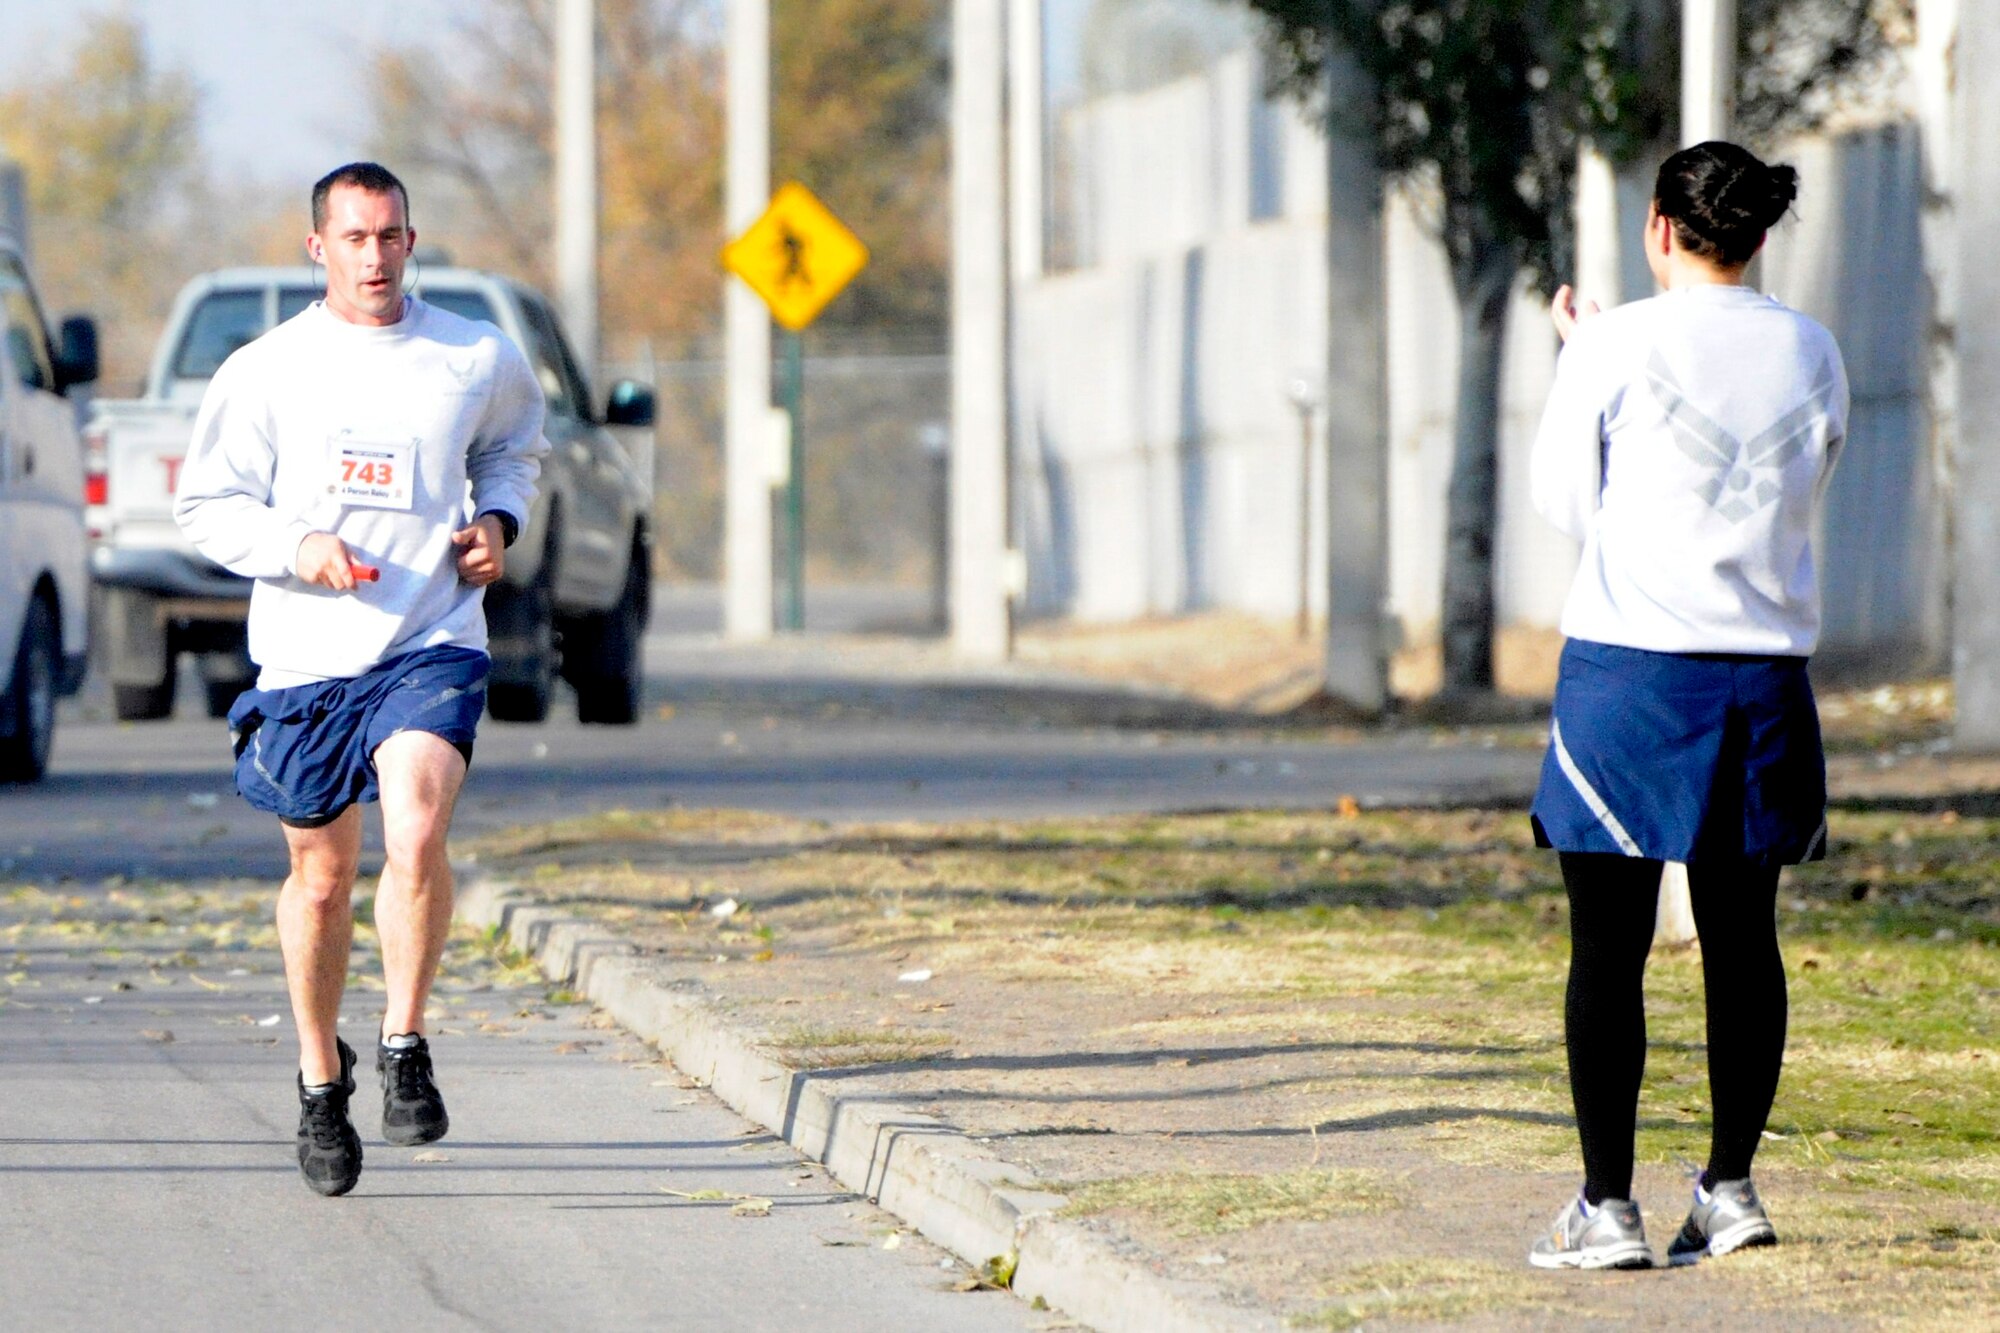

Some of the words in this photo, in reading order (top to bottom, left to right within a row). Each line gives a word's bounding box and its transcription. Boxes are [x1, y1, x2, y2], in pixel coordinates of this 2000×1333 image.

[341, 460, 392, 485] 743
[347, 487, 369, 495] Person
[371, 489, 389, 498] Relay
